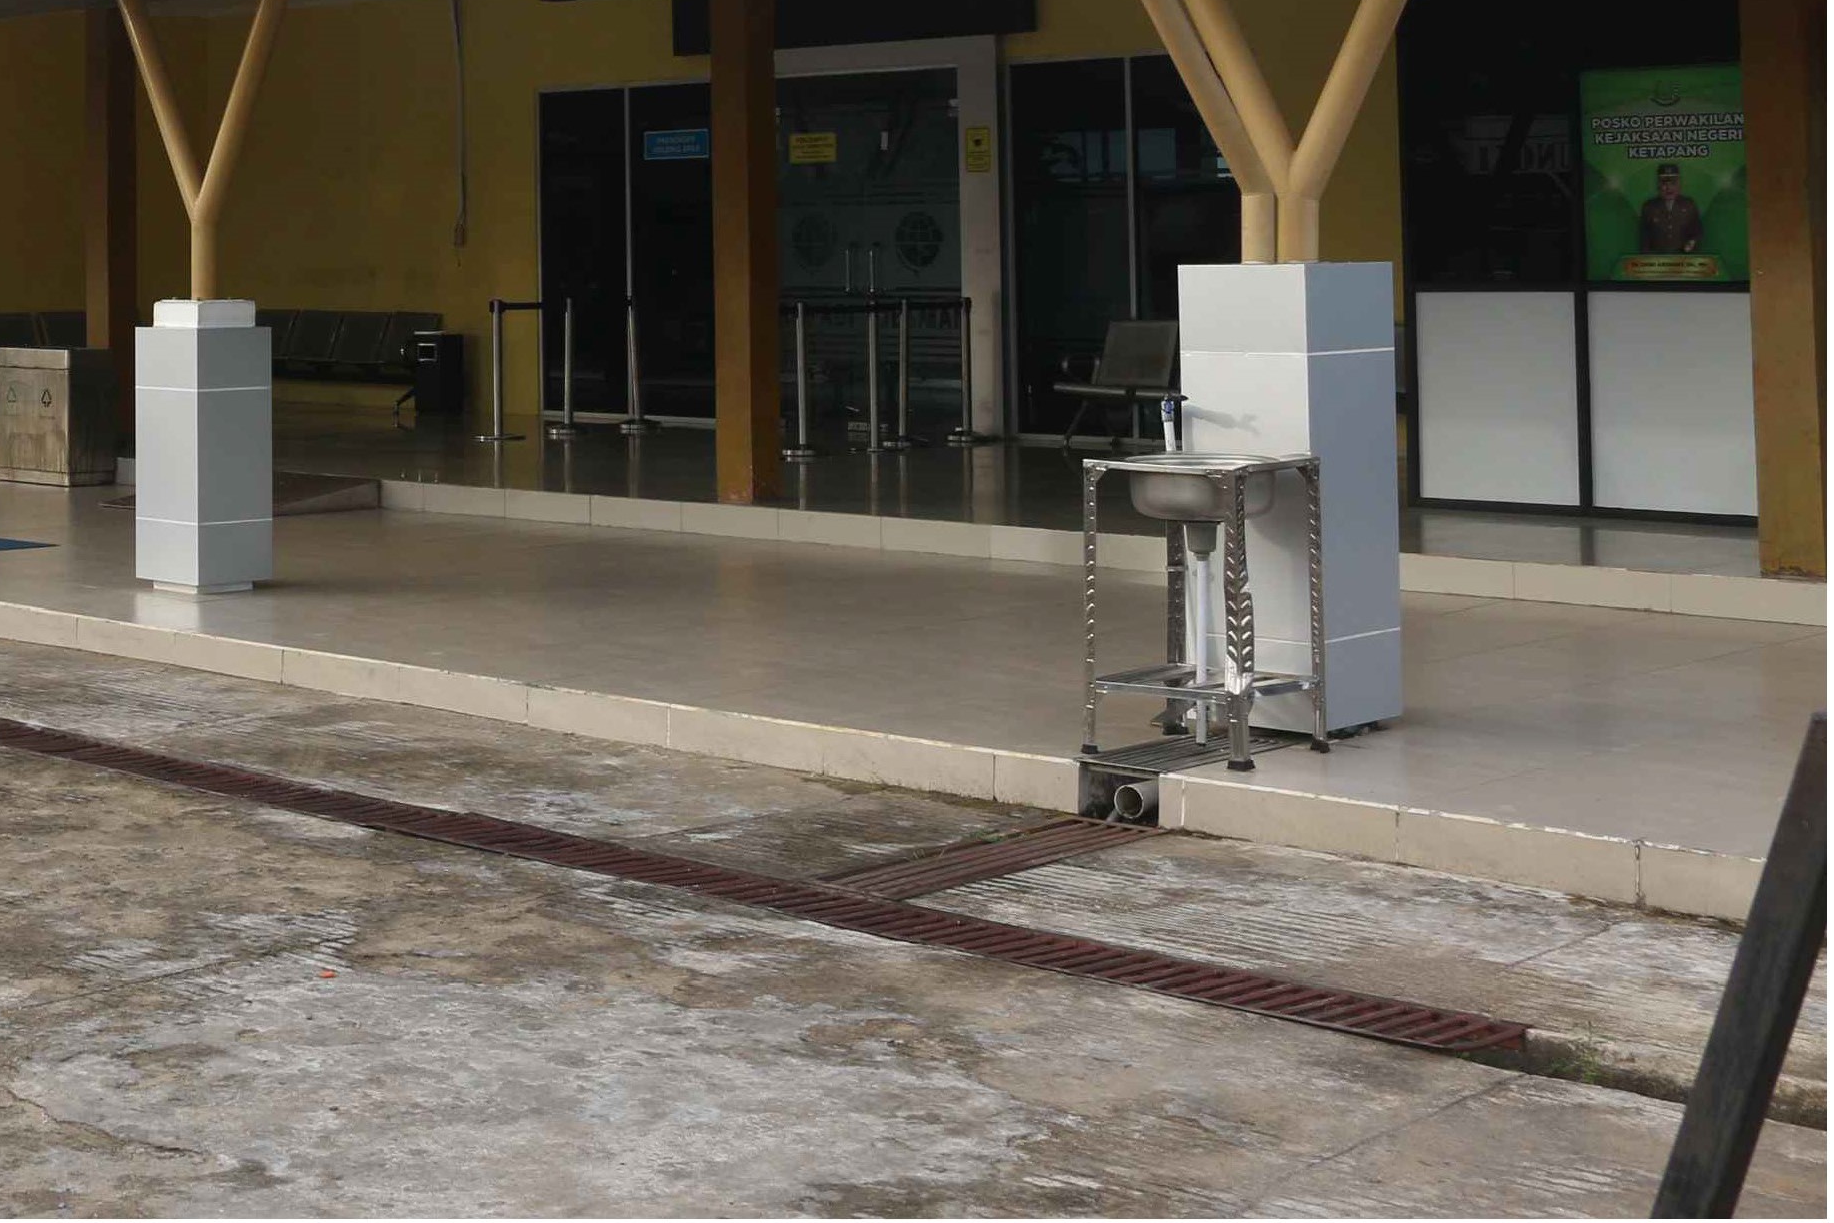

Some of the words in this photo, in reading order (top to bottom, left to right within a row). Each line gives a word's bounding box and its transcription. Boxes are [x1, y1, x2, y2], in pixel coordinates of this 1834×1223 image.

[1592, 117, 1642, 129] POSKO
[1645, 113, 1744, 127] PERWAKILAN
[1595, 131, 1683, 144] KEJAKSAAN
[1687, 128, 1743, 141] NEGERI
[1628, 145, 1709, 158] KETAPANG
